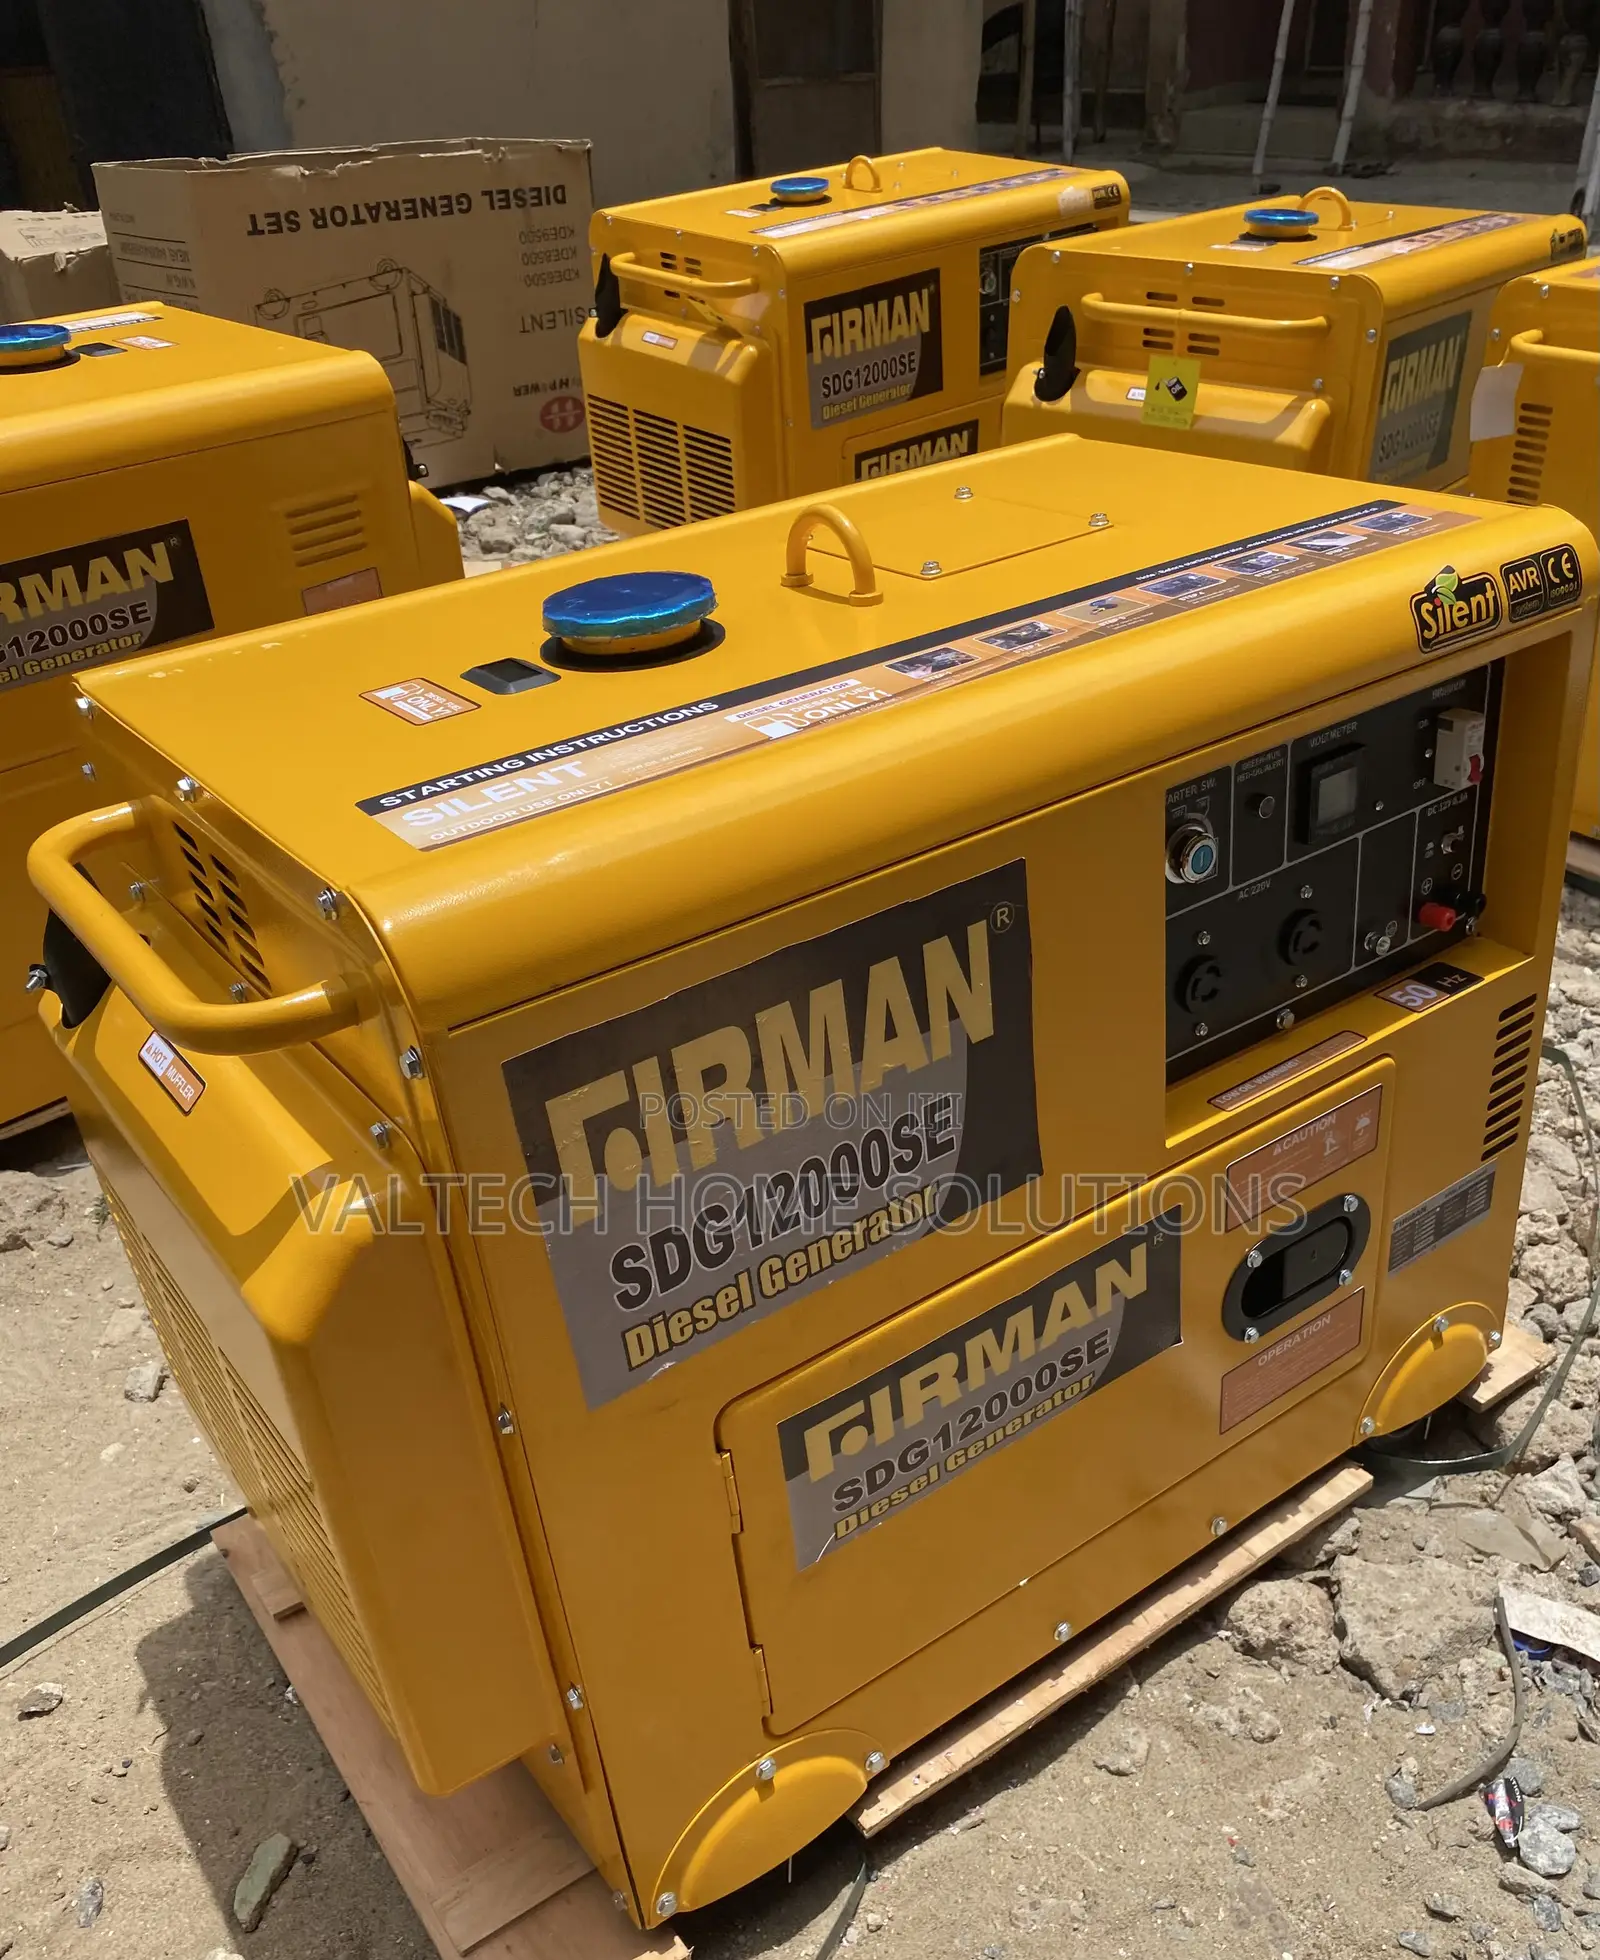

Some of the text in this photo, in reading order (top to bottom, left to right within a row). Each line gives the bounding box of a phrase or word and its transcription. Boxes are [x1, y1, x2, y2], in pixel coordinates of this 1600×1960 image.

[247, 184, 567, 236] DIESEL GENERATOR SET
[519, 306, 586, 334] SILENT
[811, 288, 930, 365] FIRMAN
[821, 351, 917, 399] SDG12000SE
[1382, 334, 1461, 420] FIRMAN
[822, 383, 913, 420] Diesel Generator
[861, 430, 969, 481] FIRMAN
[1509, 566, 1540, 595] AVR
[1420, 582, 1495, 639] Silent
[23, 631, 143, 677] Generator
[736, 682, 850, 720] DIESEL GENERATOR
[791, 696, 836, 713] DIESEL
[837, 686, 876, 698] FUEL
[803, 689, 893, 719] ONLY!
[379, 758, 526, 808] STARTING
[526, 701, 719, 763] INSTRUCTIONS
[1309, 721, 1359, 748] VOLTMETER
[402, 760, 588, 828] SILENT
[1427, 806, 1437, 817] DC
[429, 809, 520, 841] OUTDOOR
[521, 798, 556, 813] USE
[1238, 879, 1271, 900] AC 220V
[1389, 972, 1468, 1008] 50 Hz
[165, 1064, 195, 1102] MUFFLER
[545, 918, 994, 1228] FIRMAN
[1215, 1091, 1239, 1104] LOW
[1239, 1081, 1257, 1093] OIL
[1283, 1112, 1337, 1151] CAUTION
[610, 1096, 956, 1313] SDG12000SE
[623, 1181, 944, 1372] Diesel Generator
[803, 1242, 1148, 1484] FIRMAN
[1257, 1313, 1332, 1368] OPERATION
[832, 1327, 1112, 1514] SDG12000SE
[834, 1370, 1096, 1541] Diesel Generator
